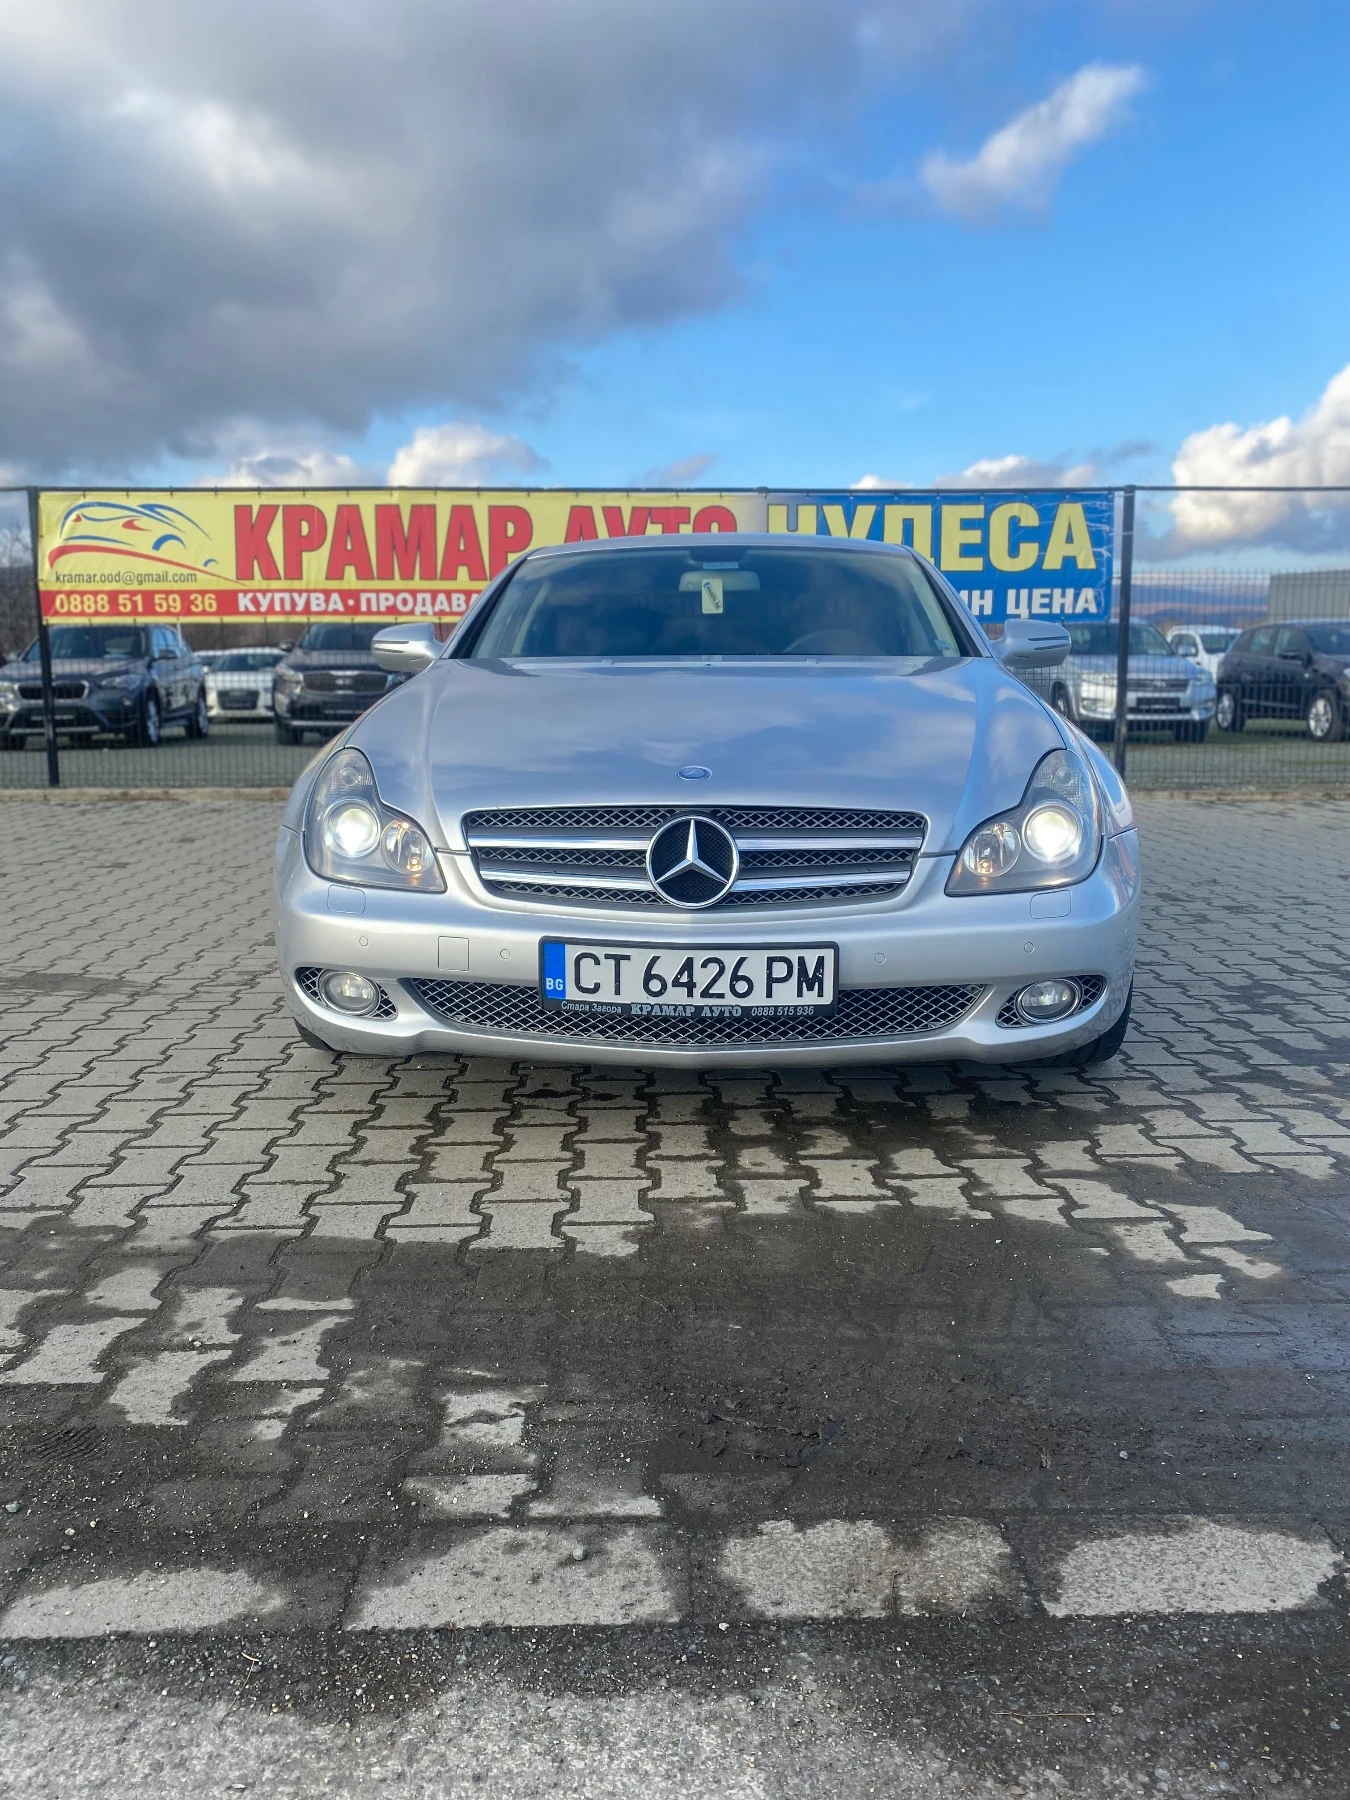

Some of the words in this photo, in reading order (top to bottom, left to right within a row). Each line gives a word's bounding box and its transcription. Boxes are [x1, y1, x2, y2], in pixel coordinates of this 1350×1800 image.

[234, 504, 533, 581] КРАМАР
[55, 571, 197, 585] kramar.ood@gmail.com
[55, 594, 110, 613] 0888
[119, 594, 143, 612] 51
[154, 594, 181, 612] 59
[190, 594, 217, 612] 36
[237, 592, 345, 613] КУПУВА
[1006, 588, 1098, 619] ЦЕНА
[545, 978, 564, 991] BG
[574, 952, 631, 996] CT
[642, 955, 754, 999] 6426
[765, 955, 825, 998] PM
[561, 1001, 590, 1012] Стара
[592, 1002, 622, 1013] Загора
[631, 1004, 696, 1017] КРАМАР
[701, 1005, 742, 1017] АУТО
[751, 1007, 775, 1017] 0888
[777, 1007, 795, 1016] 515
[797, 1006, 814, 1016] 936
